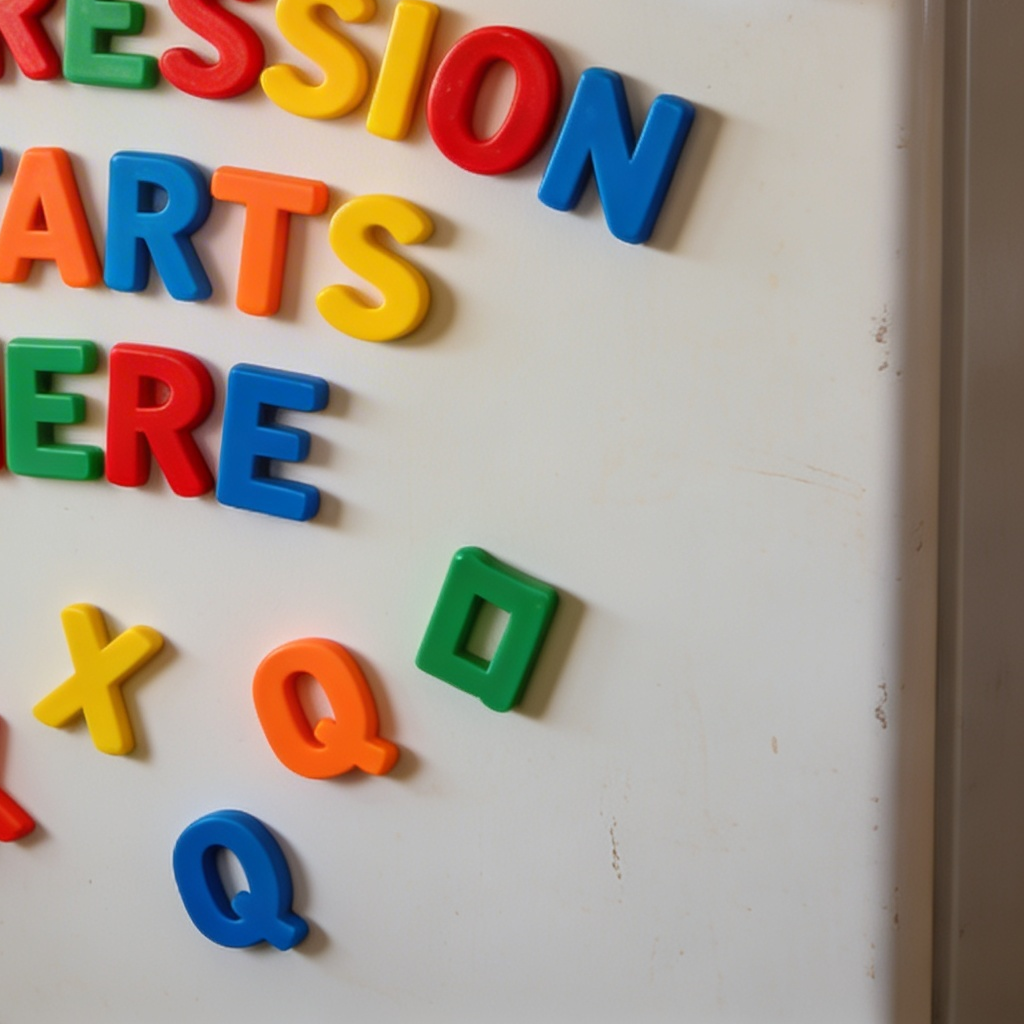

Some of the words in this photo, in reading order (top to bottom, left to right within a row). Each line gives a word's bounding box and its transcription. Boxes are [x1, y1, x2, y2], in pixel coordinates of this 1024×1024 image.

[33, 603, 165, 755] X
[252, 637, 400, 778] Q
[173, 809, 308, 951] Q
